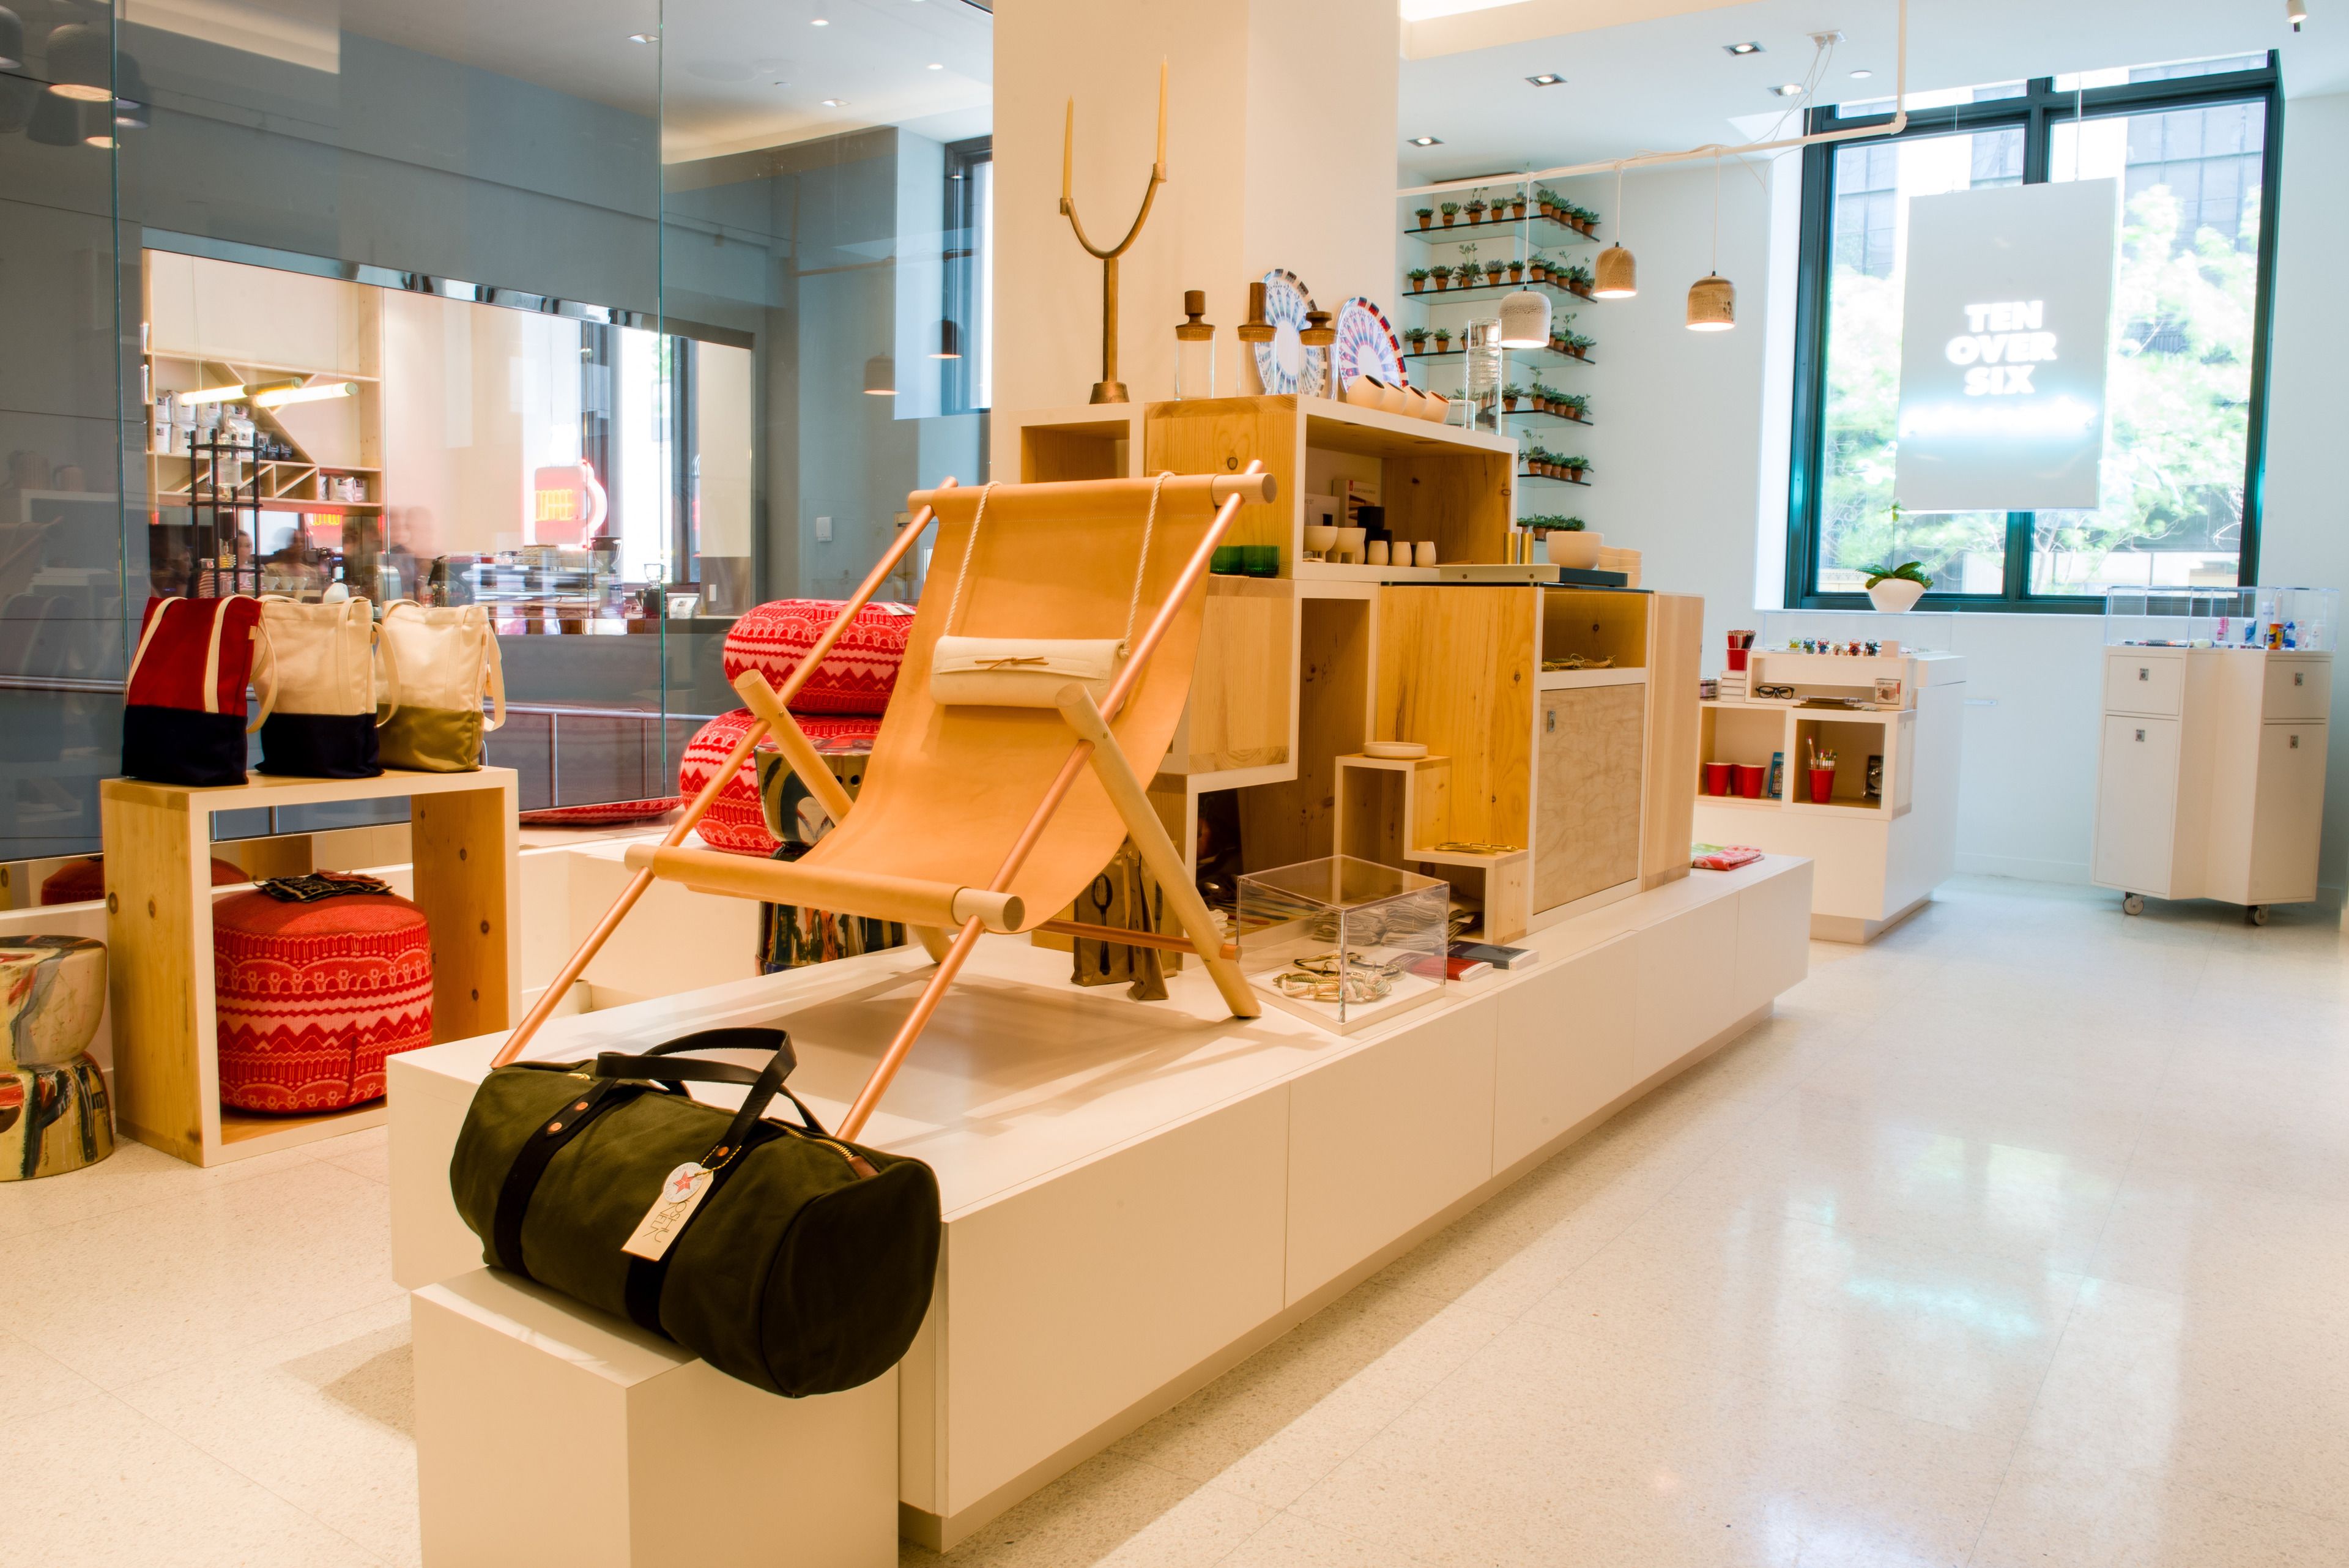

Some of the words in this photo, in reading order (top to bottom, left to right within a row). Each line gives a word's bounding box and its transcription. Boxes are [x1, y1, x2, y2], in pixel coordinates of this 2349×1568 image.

[1965, 300, 2043, 333] TEN
[1945, 332, 2057, 365] OVER
[1963, 365, 2036, 396] SIX
[654, 1200, 690, 1243] OSHU
